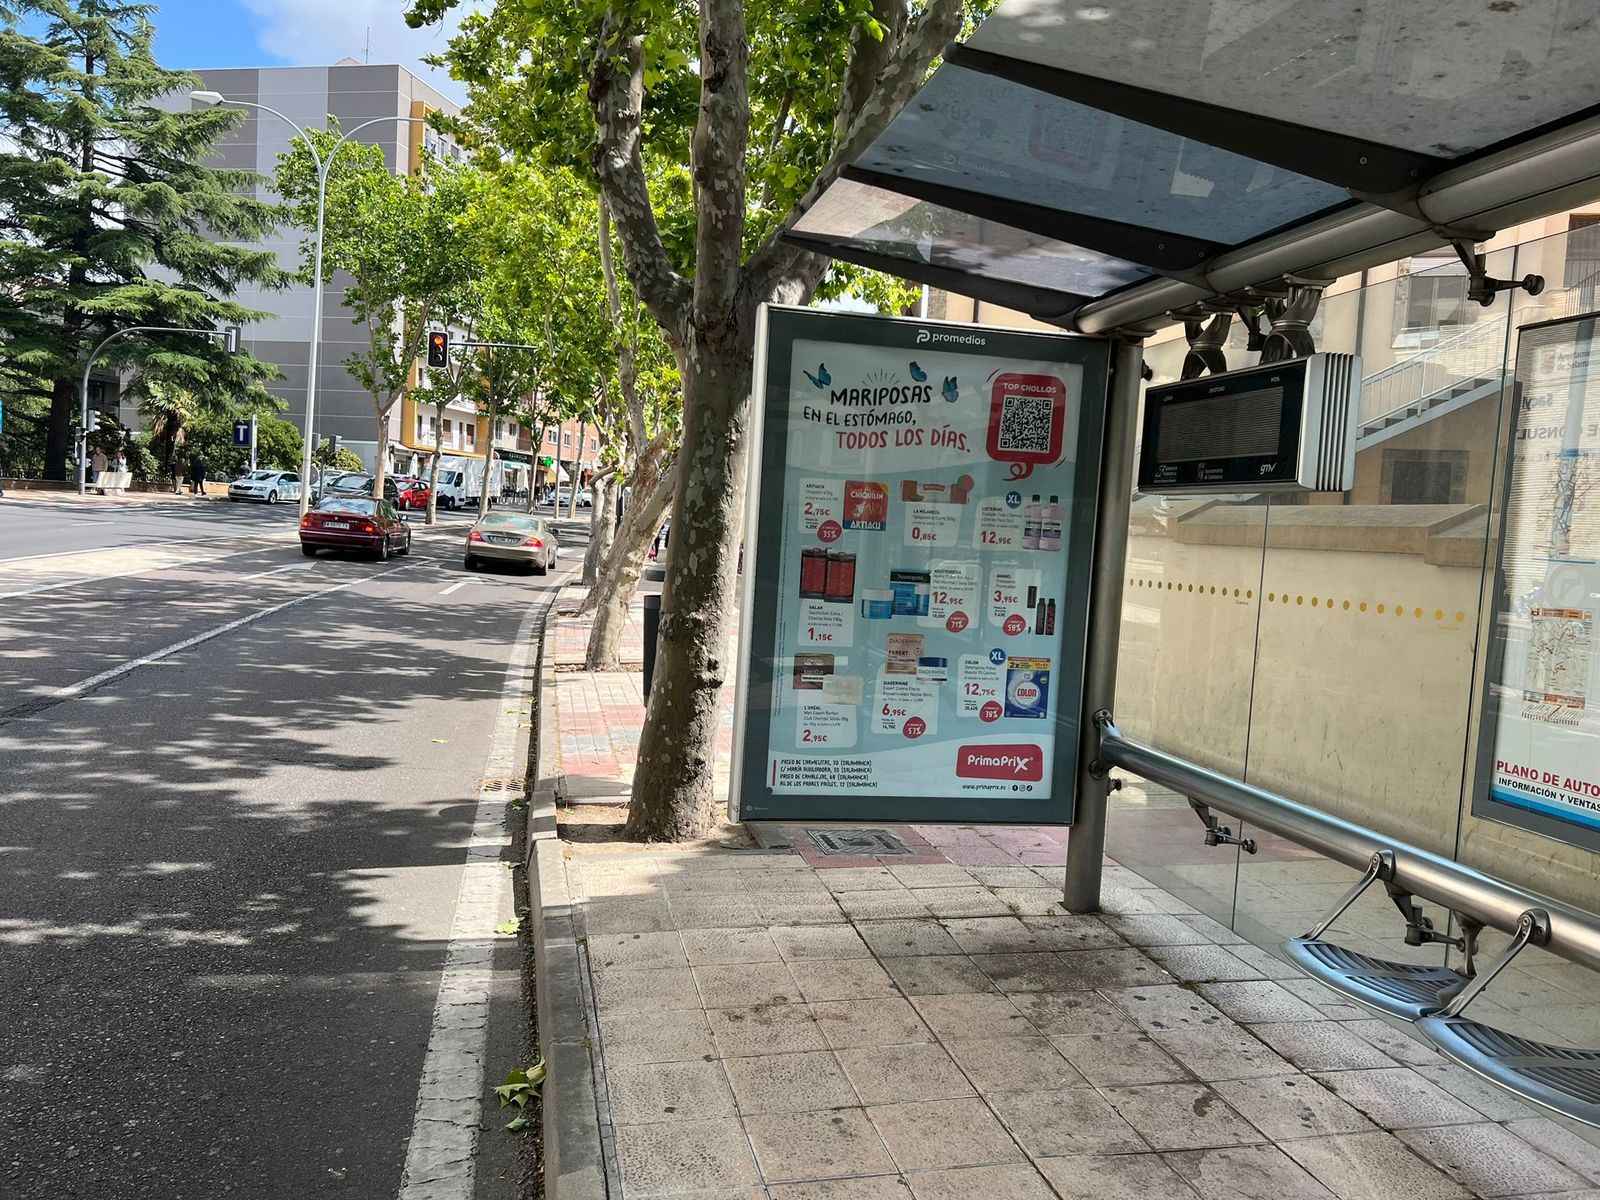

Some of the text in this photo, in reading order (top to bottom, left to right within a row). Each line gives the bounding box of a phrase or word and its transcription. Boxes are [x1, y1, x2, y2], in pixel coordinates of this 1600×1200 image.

[932, 333, 986, 346] promedios
[1003, 382, 1057, 394] TOP CHOLLOS
[830, 385, 933, 407] MARIPOSAS
[803, 406, 917, 427] EN EL ESTÓMAGO,
[836, 424, 971, 453] TODOS LOS DÍAS.
[1007, 494, 1020, 504] XL
[804, 501, 830, 516] 2,75€
[823, 530, 837, 539] 35%
[912, 527, 937, 541] 0,85€
[981, 530, 1012, 545] 12,95€
[932, 591, 964, 605] 12,95€
[994, 590, 1018, 604] 3,95€
[808, 627, 833, 641] 1,15€
[991, 651, 1004, 661] XL
[964, 683, 996, 697] 12,75€
[1017, 688, 1037, 698] COLON
[882, 703, 907, 717] 6,95€
[802, 729, 828, 743] 2,95€
[1496, 760, 1538, 780] PLANO
[1543, 772, 1560, 786] DE
[1498, 777, 1557, 799] INFORMACIÓN
[1560, 794, 1565, 802] Y
